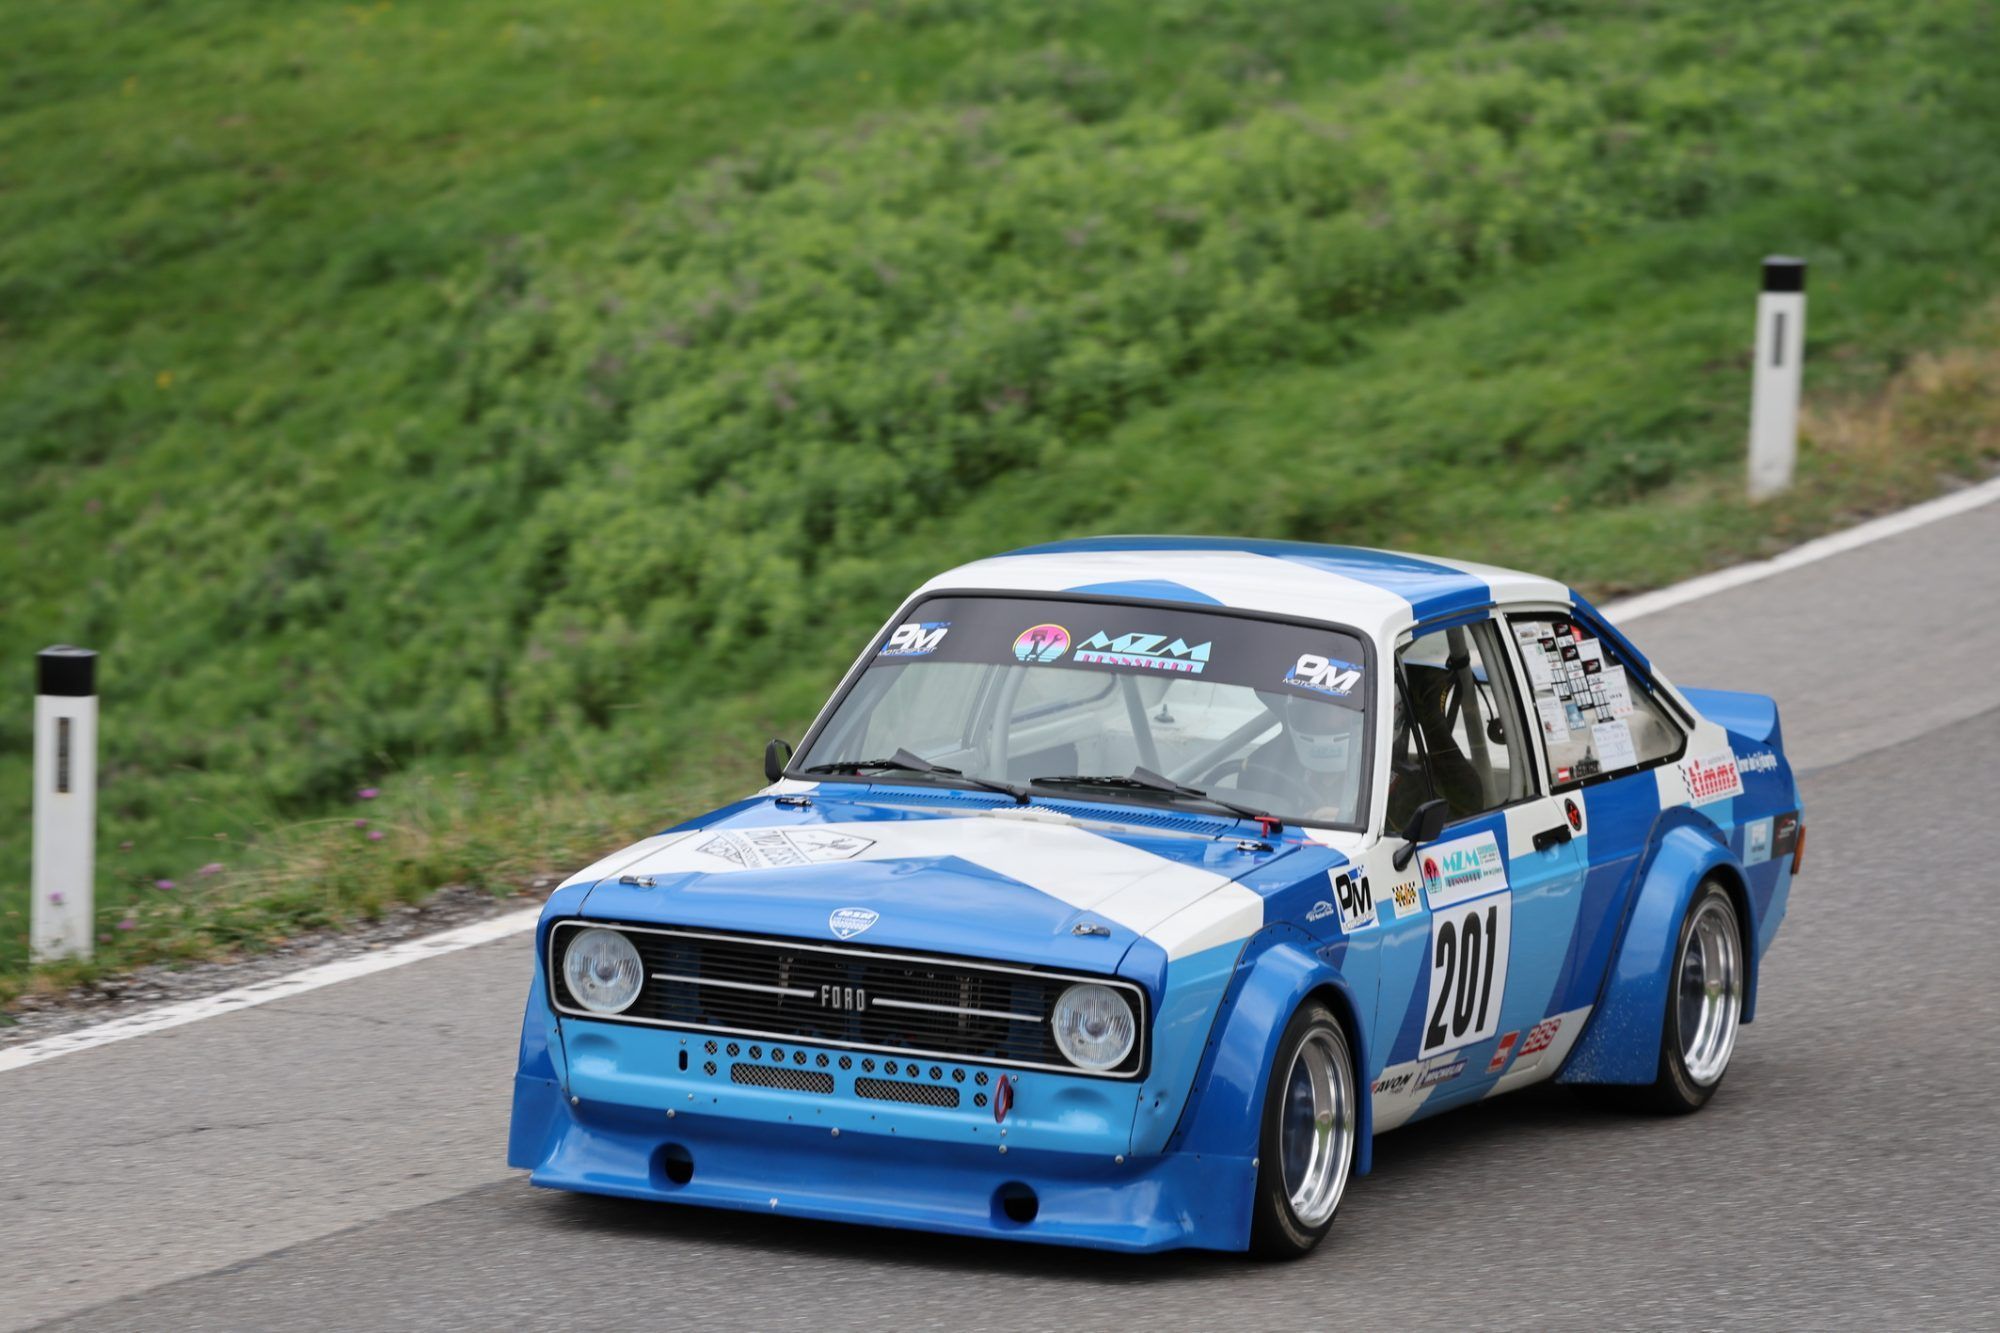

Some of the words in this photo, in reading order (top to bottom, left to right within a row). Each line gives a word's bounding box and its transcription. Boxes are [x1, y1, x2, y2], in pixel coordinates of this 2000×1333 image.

[1076, 630, 1211, 662] MZM
[1424, 905, 1497, 1051] 201
[821, 985, 866, 1012] FORD
[1374, 1072, 1414, 1094] AVON
